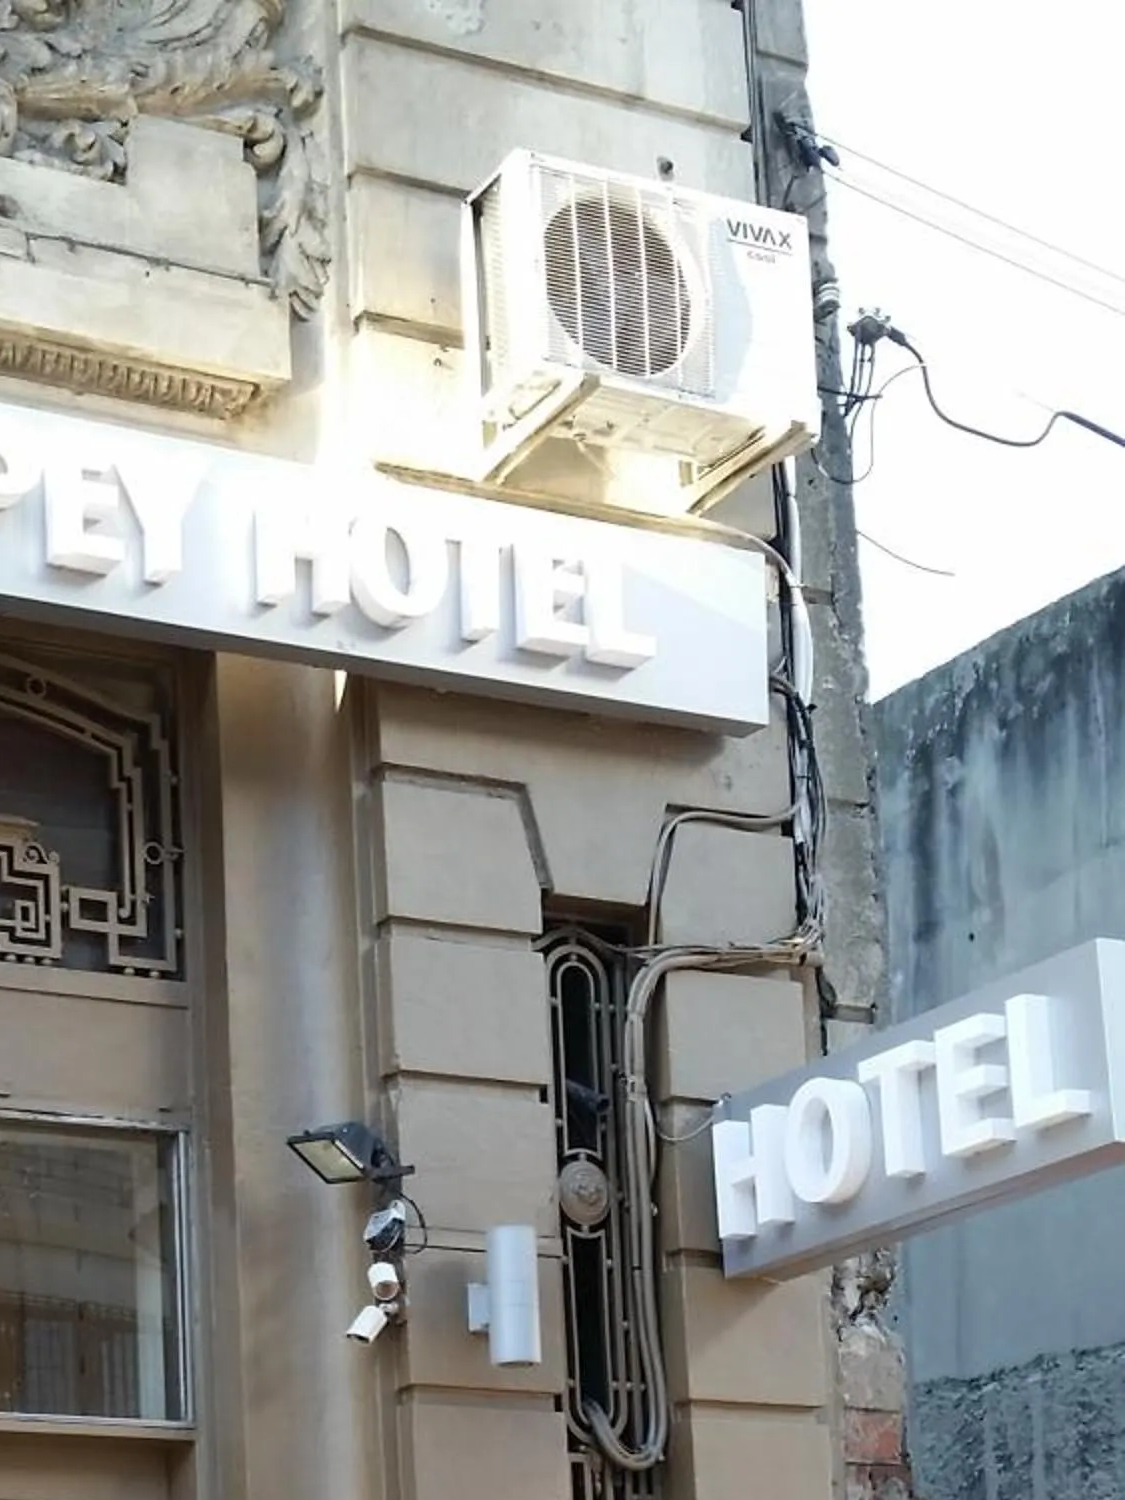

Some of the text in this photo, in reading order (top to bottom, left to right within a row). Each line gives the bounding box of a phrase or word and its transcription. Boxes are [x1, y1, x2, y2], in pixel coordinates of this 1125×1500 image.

[726, 217, 792, 250] VIVAX
[255, 478, 656, 668] HOTEL
[713, 994, 1092, 1238] HOTEL
